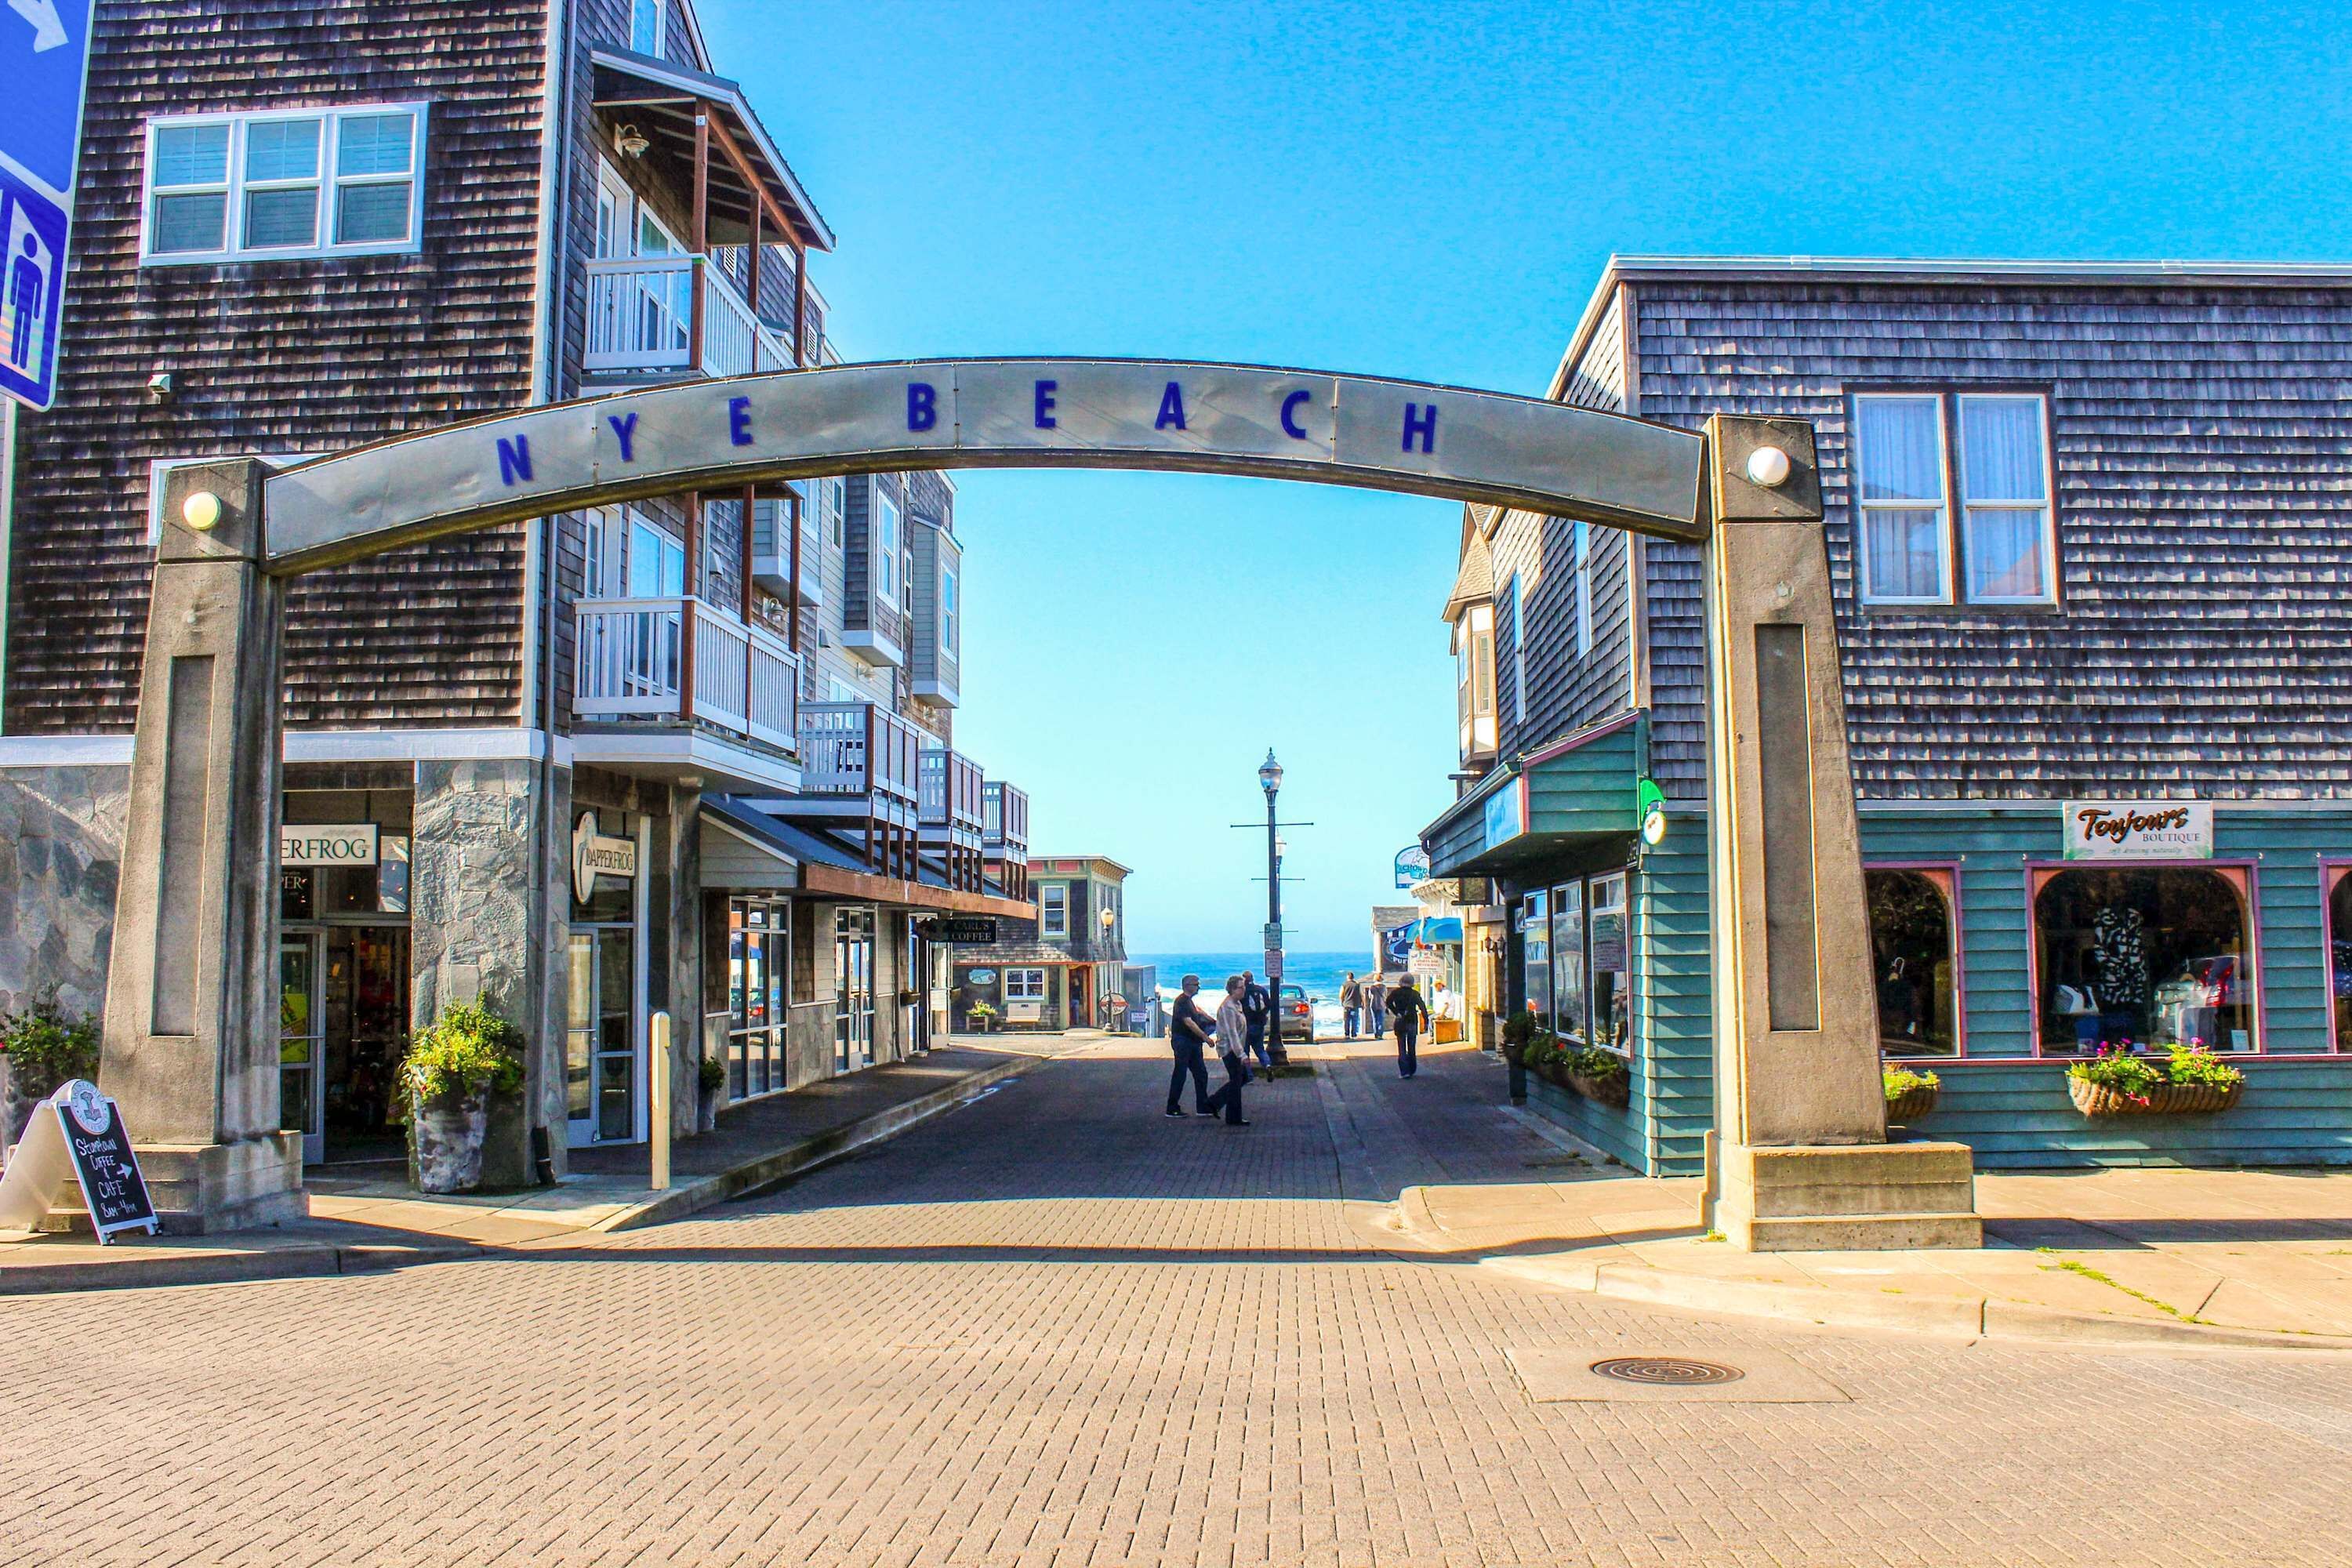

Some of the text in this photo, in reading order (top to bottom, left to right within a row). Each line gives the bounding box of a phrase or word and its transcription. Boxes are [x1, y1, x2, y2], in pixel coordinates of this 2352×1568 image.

[496, 379, 1438, 486] NYE BEACH
[2078, 808, 2188, 843] Toujours
[2143, 833, 2201, 844] BOUTIQUE
[952, 931, 992, 941] COFFEE
[98, 1180, 126, 1199] CAFE
